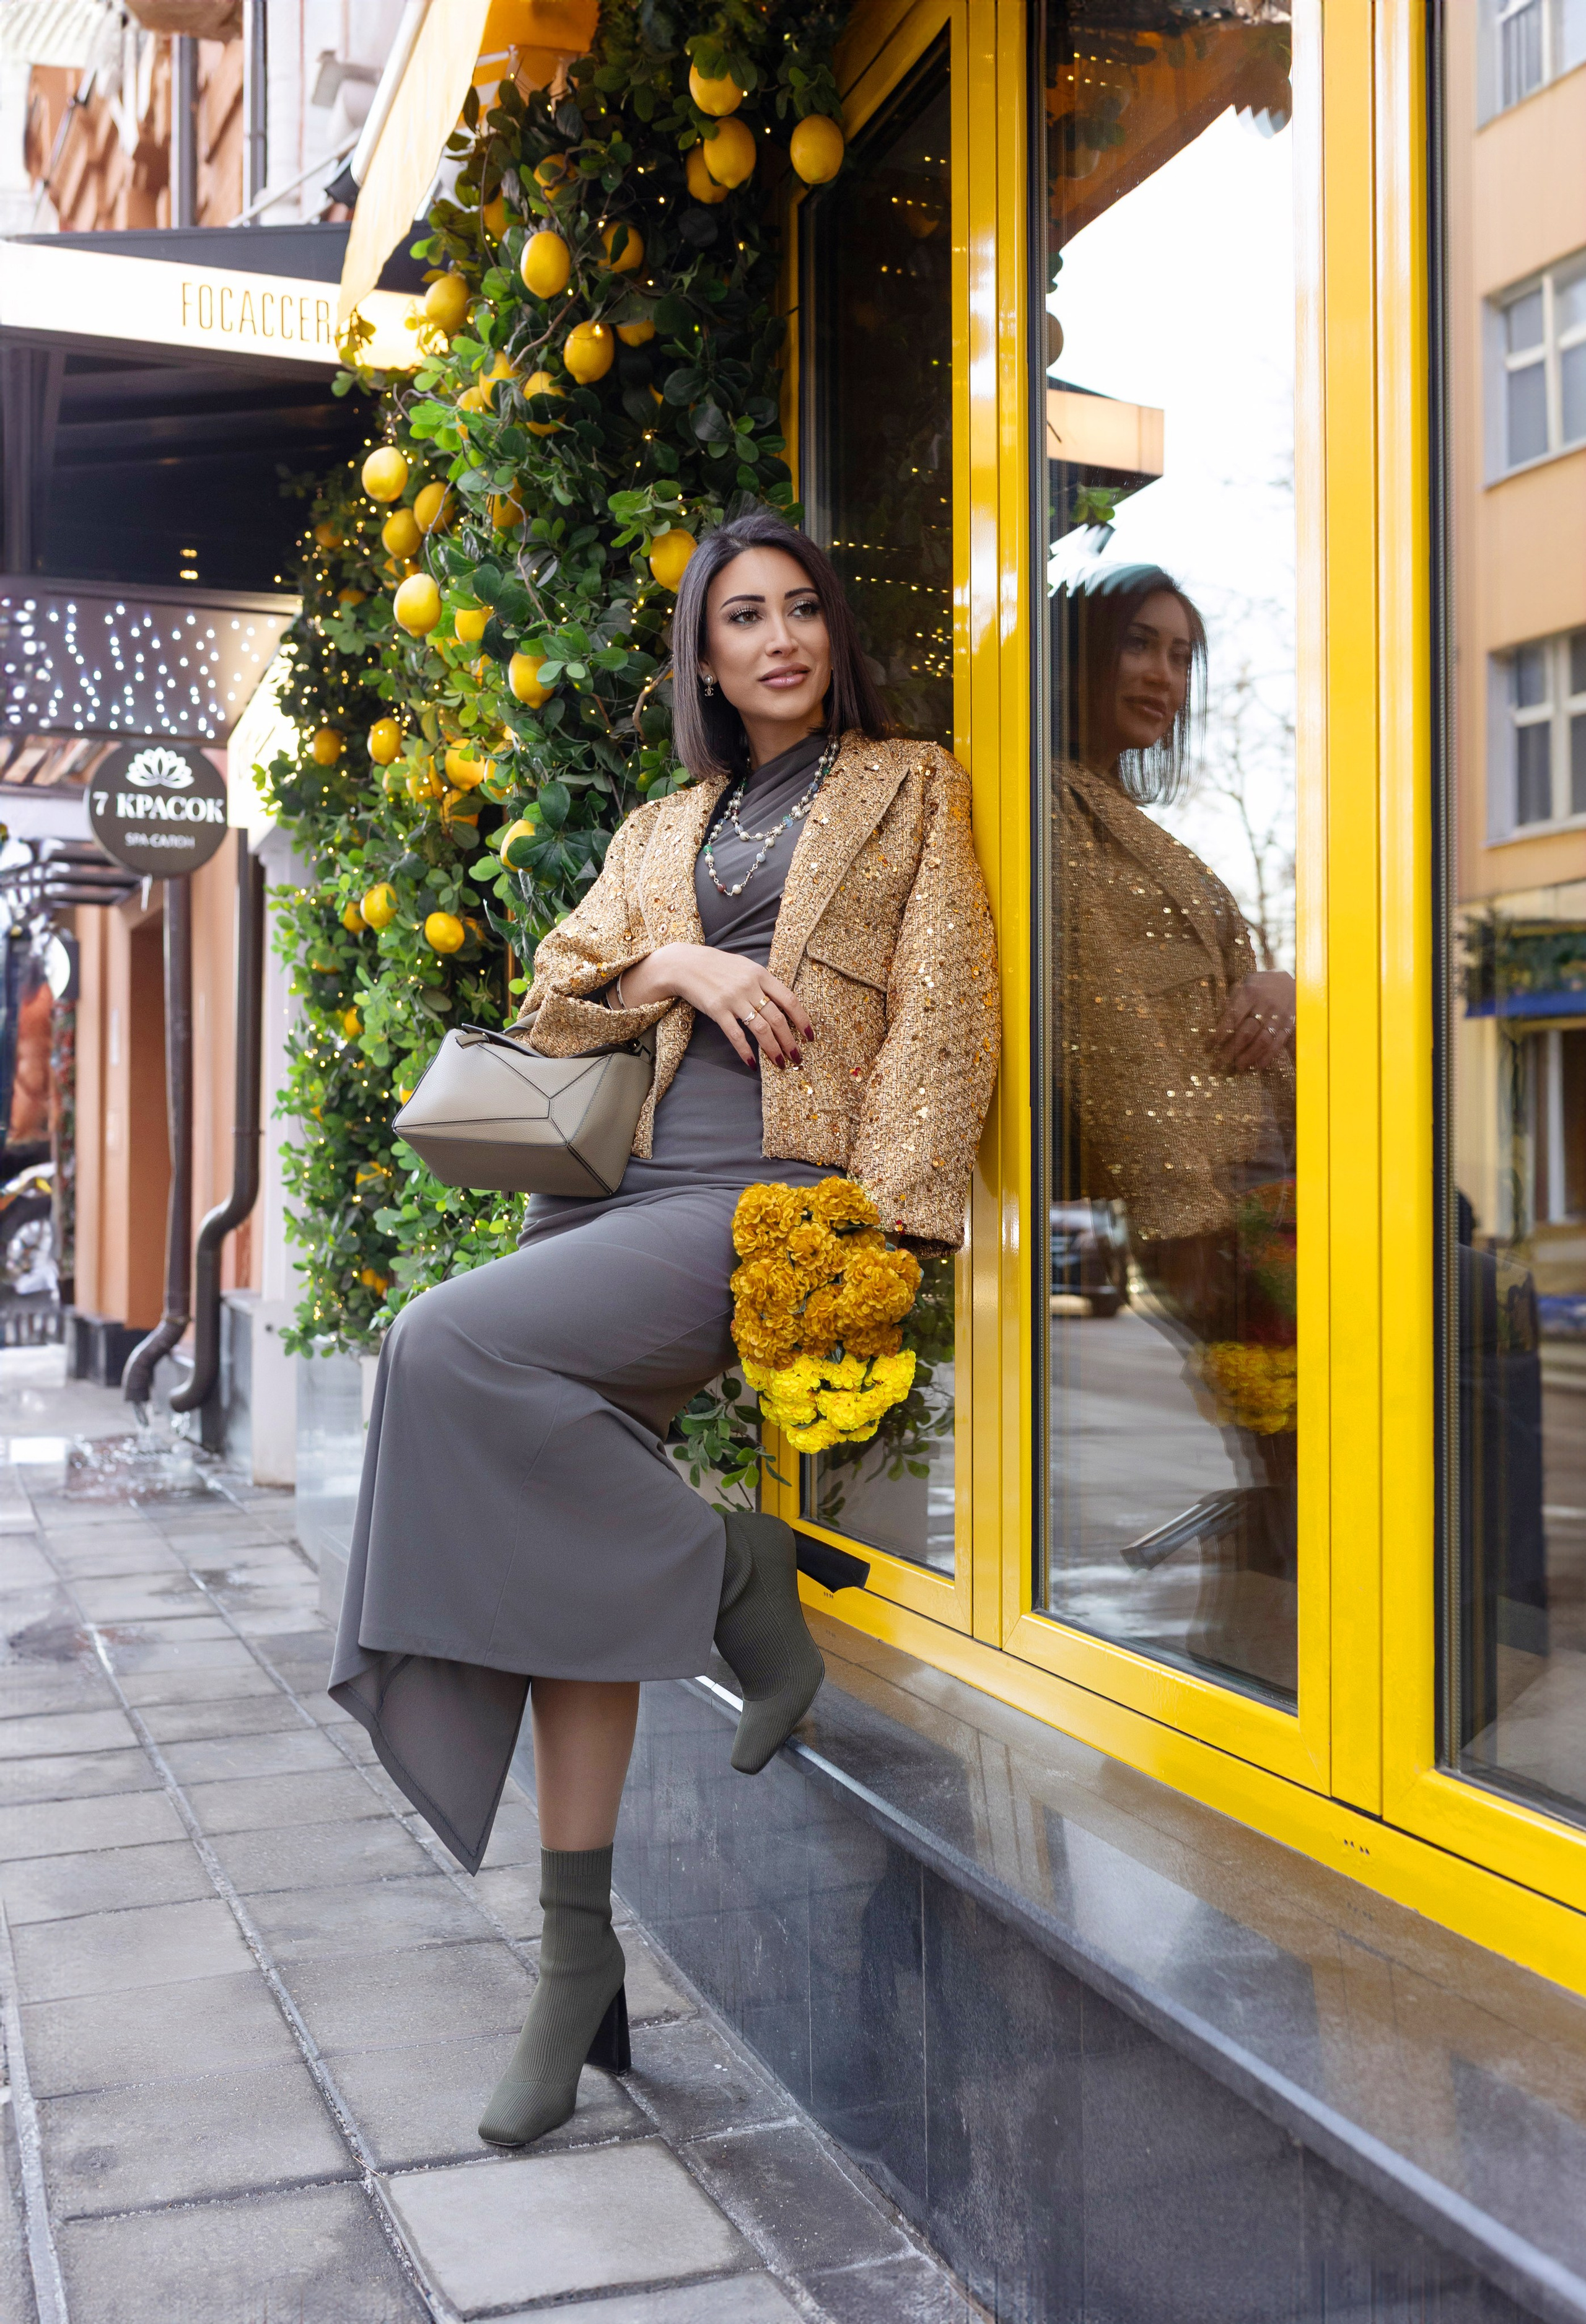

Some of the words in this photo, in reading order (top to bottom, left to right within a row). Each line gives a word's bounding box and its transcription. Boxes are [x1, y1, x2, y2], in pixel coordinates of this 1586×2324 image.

[182, 282, 330, 344] FOCACCER
[92, 790, 109, 816] 7
[116, 792, 224, 823] КРАСОК
